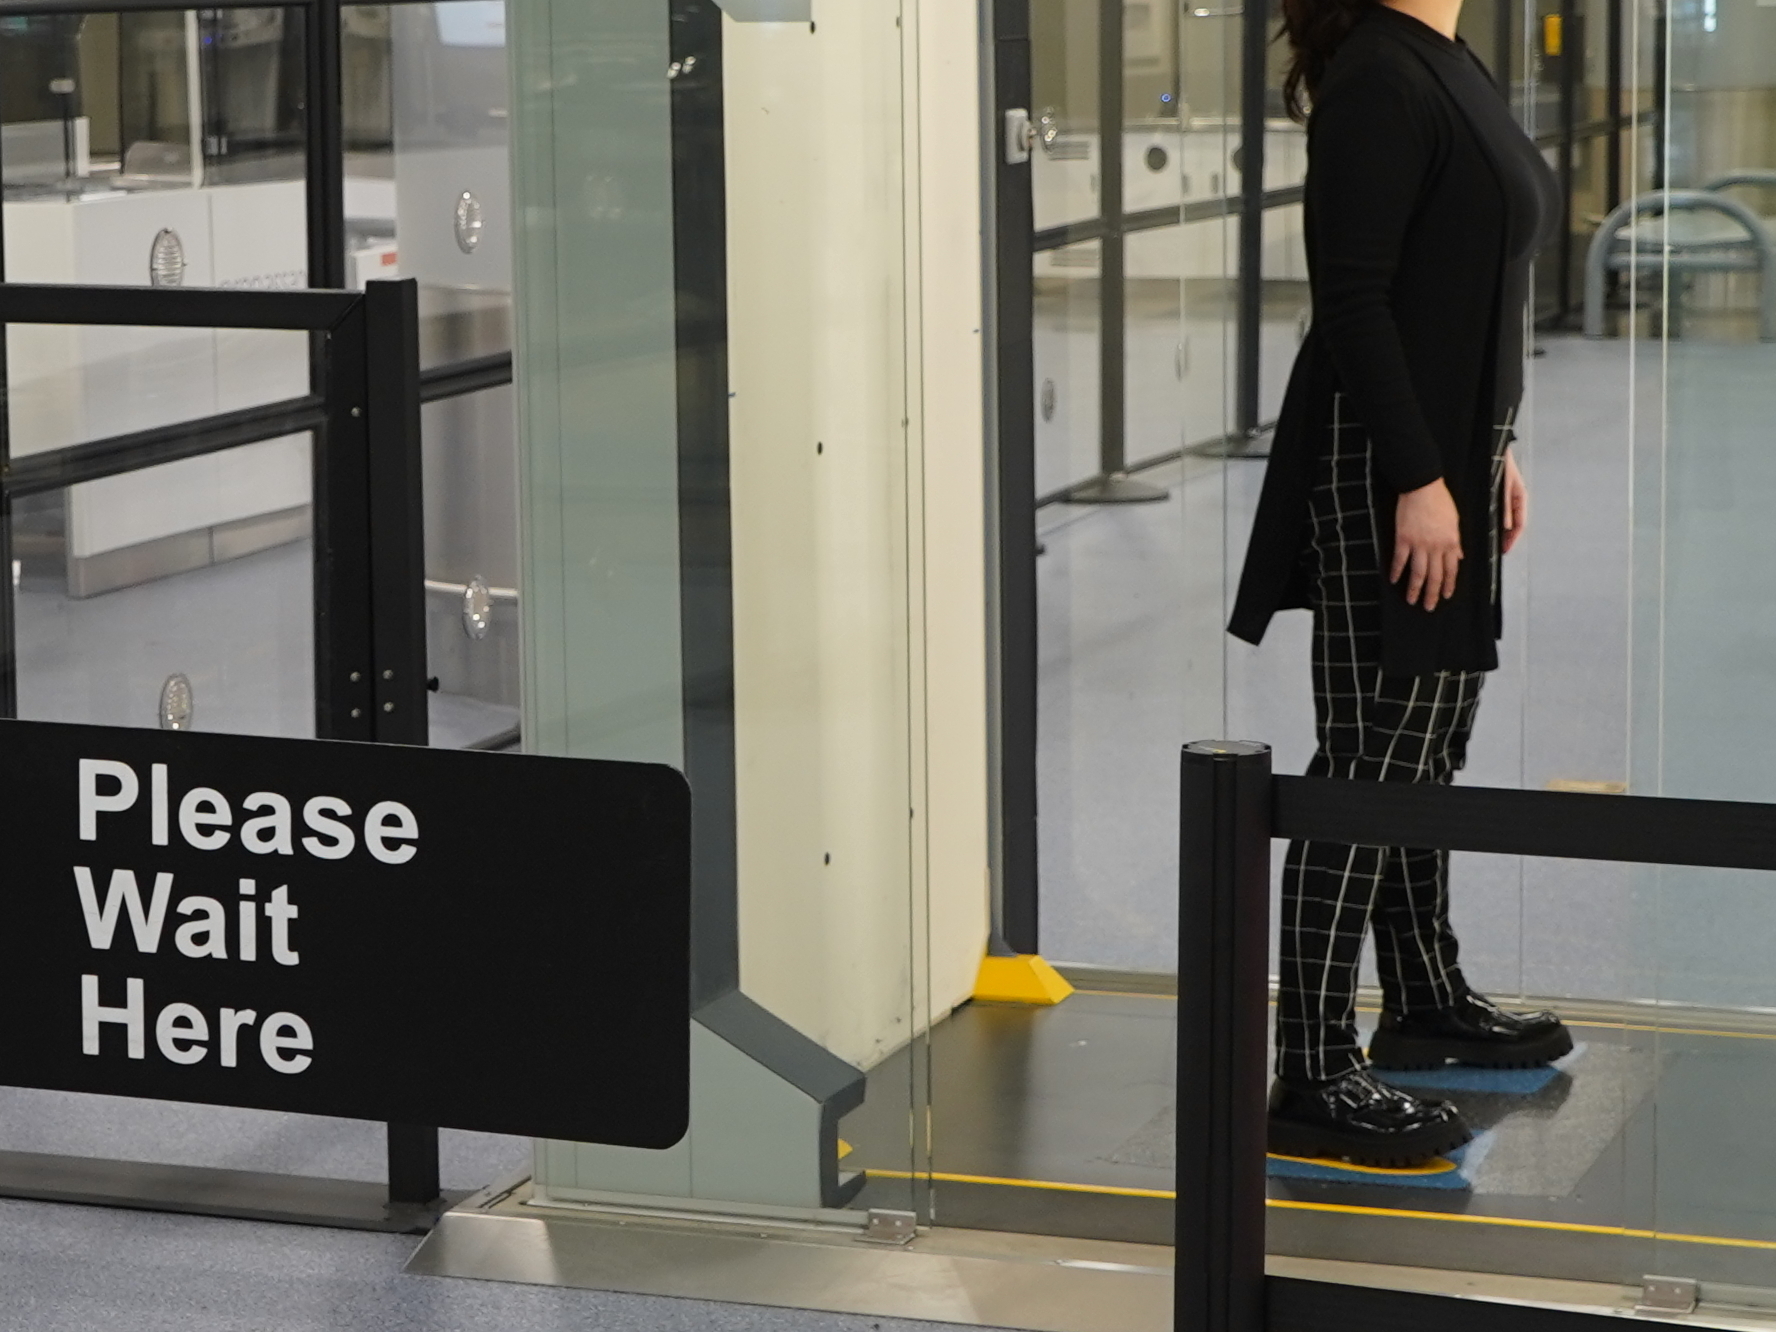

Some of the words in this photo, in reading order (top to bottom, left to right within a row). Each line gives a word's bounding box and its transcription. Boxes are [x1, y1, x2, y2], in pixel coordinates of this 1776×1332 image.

[77, 757, 420, 865] Please
[73, 865, 301, 966] Wait
[80, 973, 314, 1075] Here
